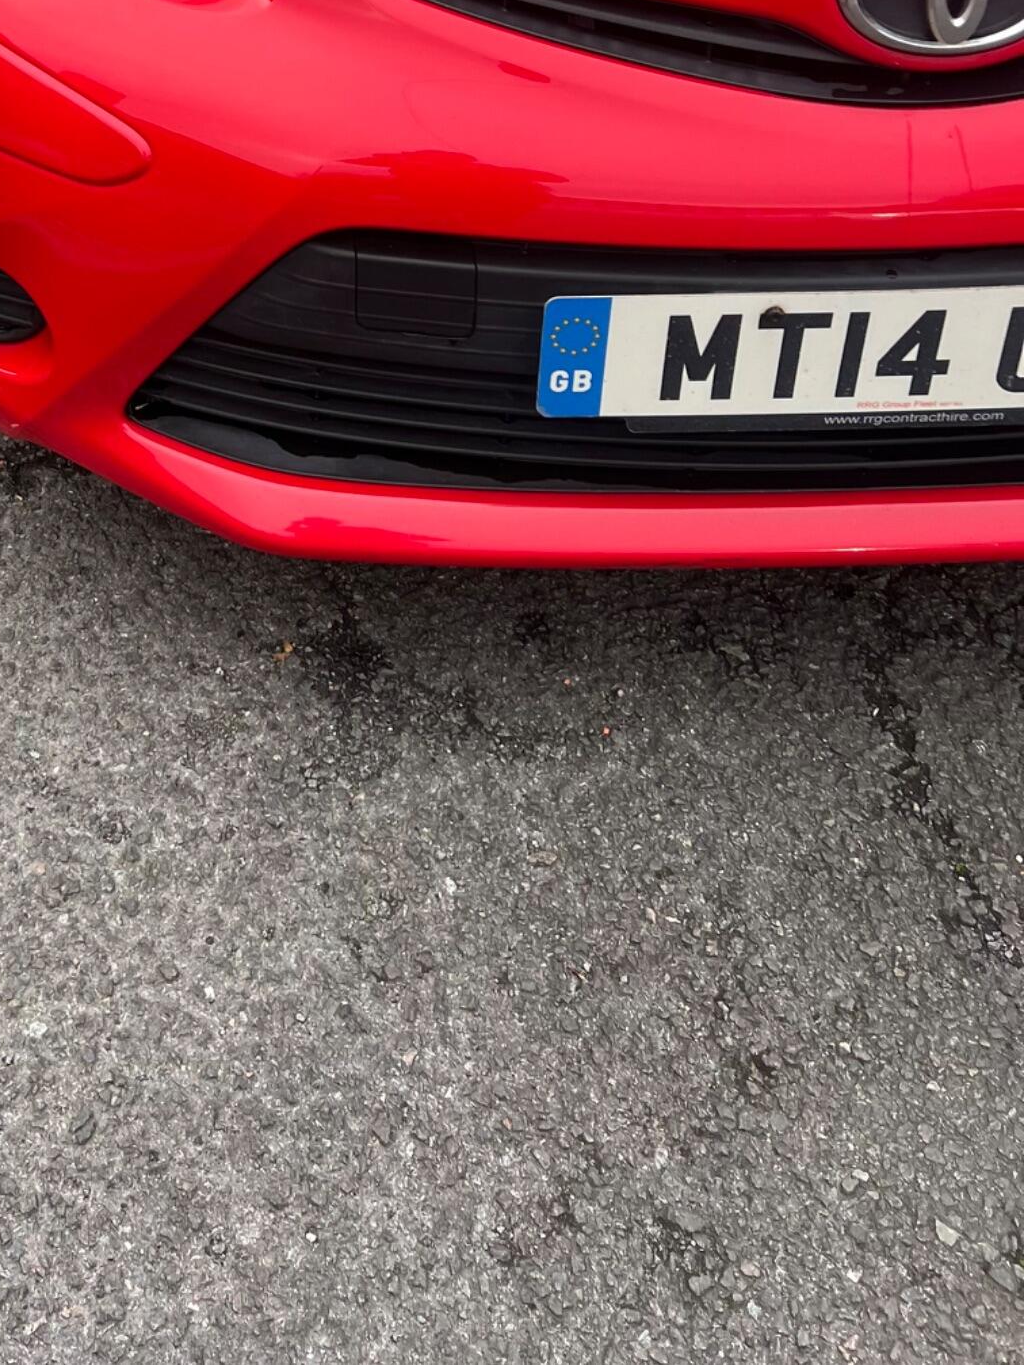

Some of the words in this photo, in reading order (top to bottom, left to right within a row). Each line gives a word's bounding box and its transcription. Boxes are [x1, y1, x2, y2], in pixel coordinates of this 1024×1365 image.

[659, 309, 950, 401] MT14
[549, 369, 593, 393] GB
[824, 411, 1005, 426] www.rrgcontracthire.com
